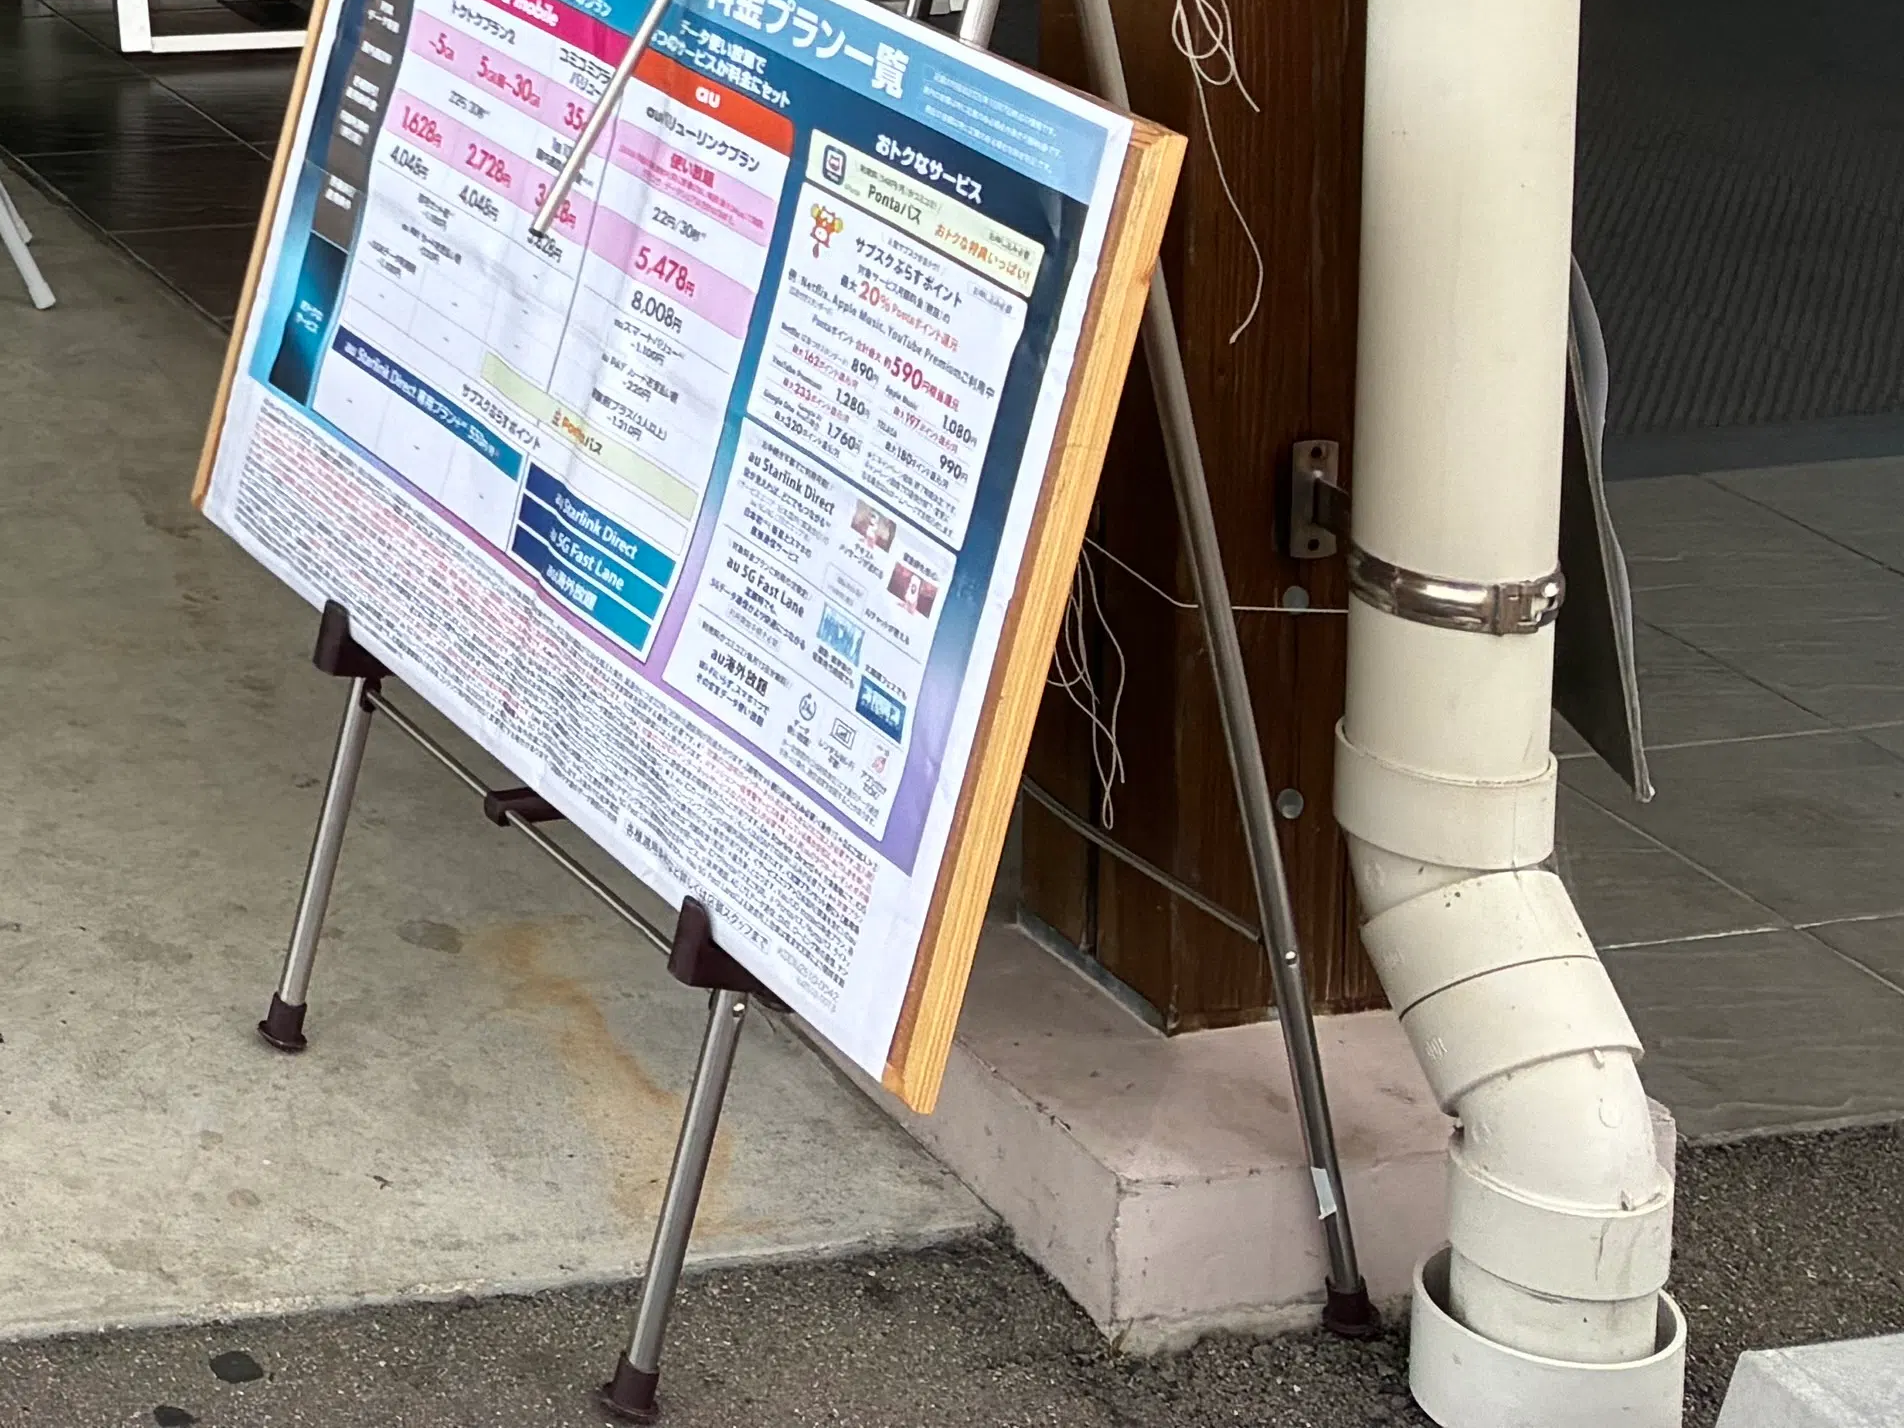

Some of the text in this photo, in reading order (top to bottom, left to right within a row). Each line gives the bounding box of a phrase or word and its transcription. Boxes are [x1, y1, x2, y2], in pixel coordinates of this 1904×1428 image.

[559, 47, 612, 84] コミコミプラ
[695, 86, 721, 108] au
[875, 133, 982, 204] おトクなサービス
[867, 183, 923, 225] Pontaパス
[634, 245, 696, 298] 5,478円
[855, 236, 962, 309] サブスクぷらすポイント
[631, 289, 683, 334] 8,008円
[761, 456, 802, 494] Starlink
[803, 482, 835, 516] Direct
[939, 454, 969, 484] 990円
[563, 497, 602, 538] Starlink
[602, 520, 639, 561] Direct
[572, 539, 597, 572] Fast
[596, 553, 625, 591] Lane
[756, 573, 779, 600] Fast
[780, 590, 805, 619] Lane
[710, 647, 769, 697] au海外放題
